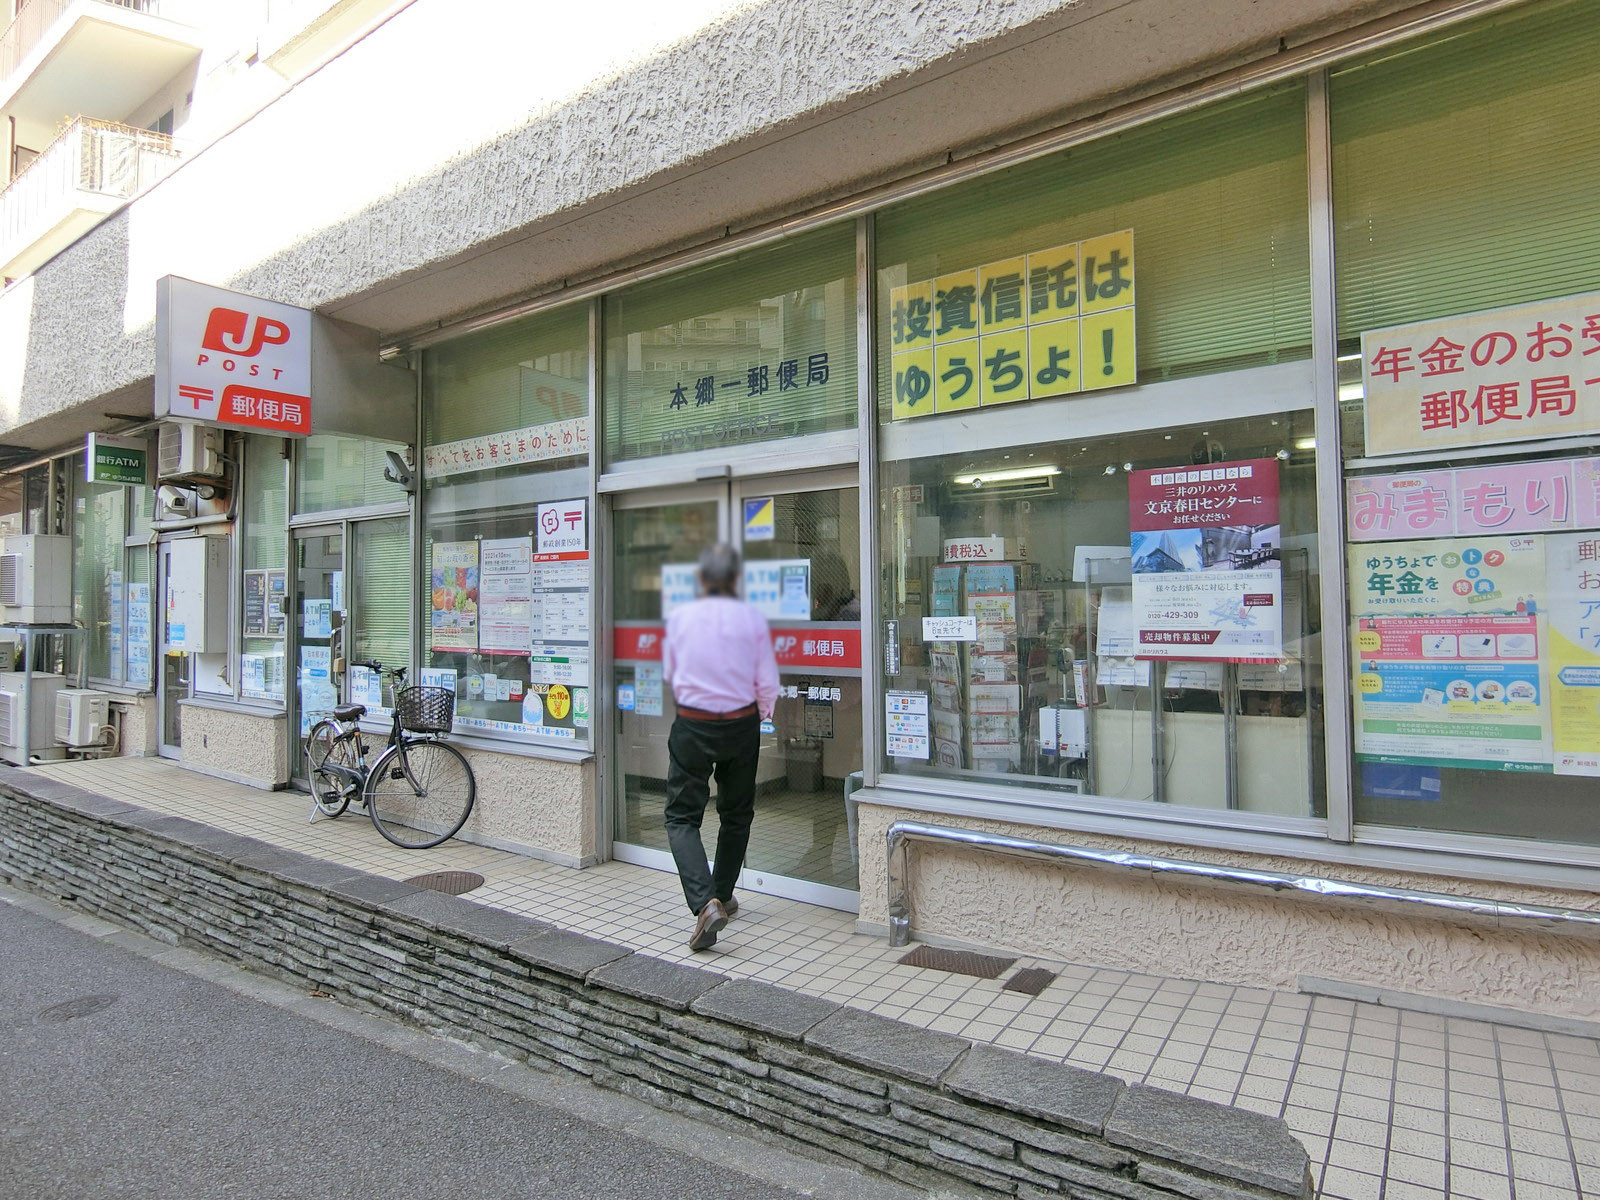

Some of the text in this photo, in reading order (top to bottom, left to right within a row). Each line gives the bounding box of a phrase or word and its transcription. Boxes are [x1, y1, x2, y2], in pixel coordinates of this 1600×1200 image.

[892, 250, 1131, 345] 投資信託は
[202, 308, 290, 357] JP
[197, 354, 283, 380] POST
[669, 352, 829, 410] 本郷一郵便局
[232, 395, 303, 425] 郵便局
[660, 413, 780, 449] POST OFFICE
[96, 455, 139, 467] 銀行ATM
[1153, 468, 1249, 484] 不動産のことなら
[1165, 483, 1237, 497] 三井のリハウス
[1144, 495, 1262, 515] 文京春日センターに
[1355, 475, 1600, 531] みまもり
[1173, 513, 1231, 524] お任せください
[1366, 555, 1438, 570] ゆうちょで
[1156, 583, 1252, 592] 様々なお悩みに対応します。
[1367, 571, 1439, 595] 年金を
[1148, 610, 1199, 619] 0120-429-309
[926, 619, 973, 627] キャッシュコーナーは
[1144, 632, 1211, 642] 売却物件募集中
[803, 640, 844, 657] 郵便局
[422, 675, 441, 685] ATM
[535, 727, 551, 735] ATM
